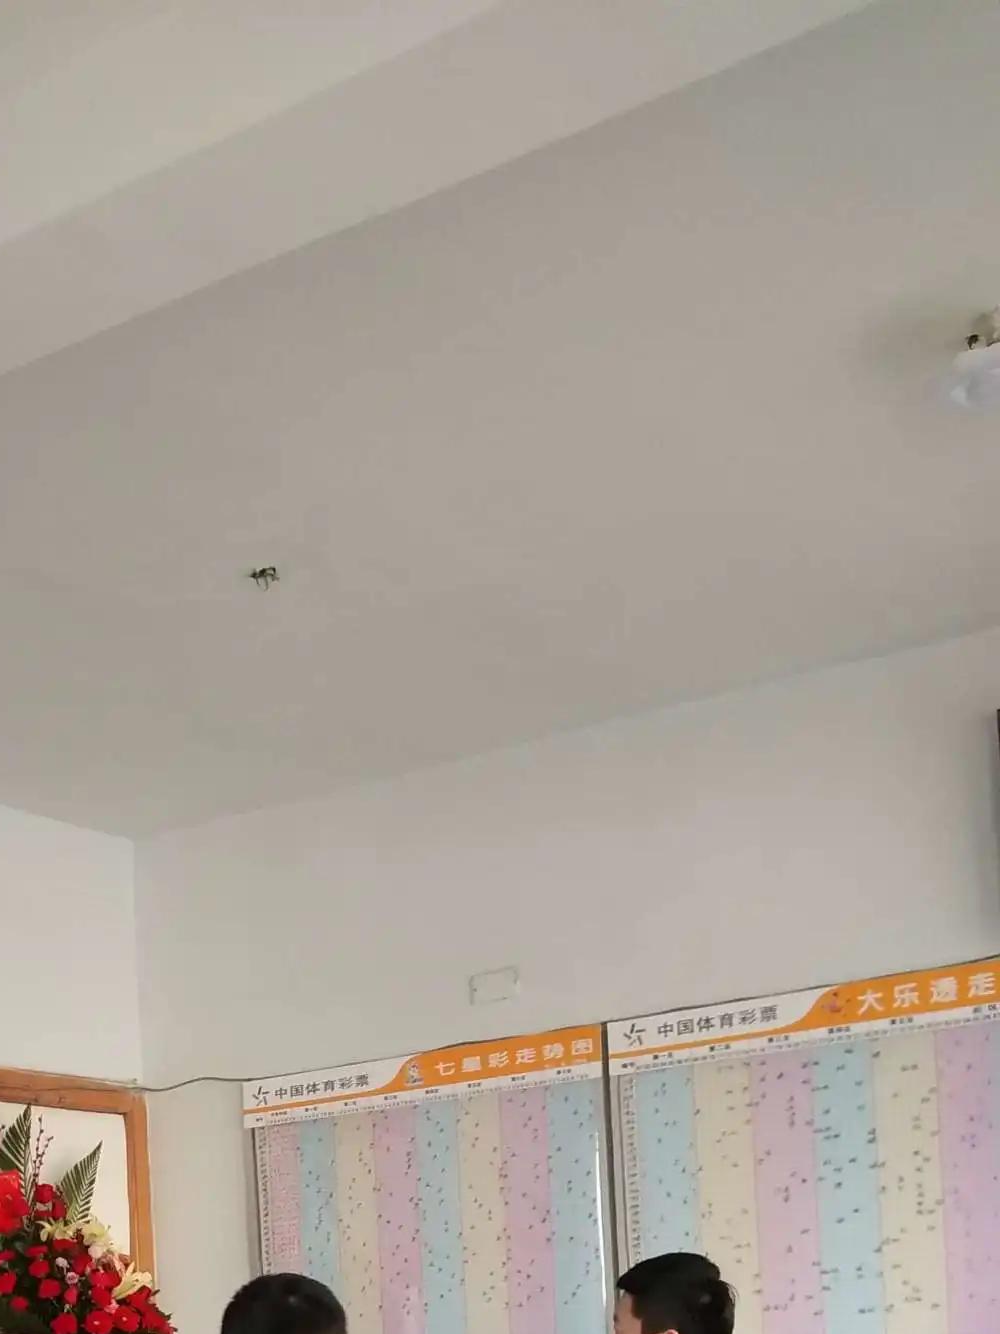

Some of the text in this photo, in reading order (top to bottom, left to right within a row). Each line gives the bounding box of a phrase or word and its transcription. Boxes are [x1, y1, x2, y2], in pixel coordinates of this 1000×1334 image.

[657, 1004, 778, 1038] 中国体育彩票
[434, 1038, 593, 1077] 七星彩走势图
[274, 1073, 369, 1100] 中国体育彩票
